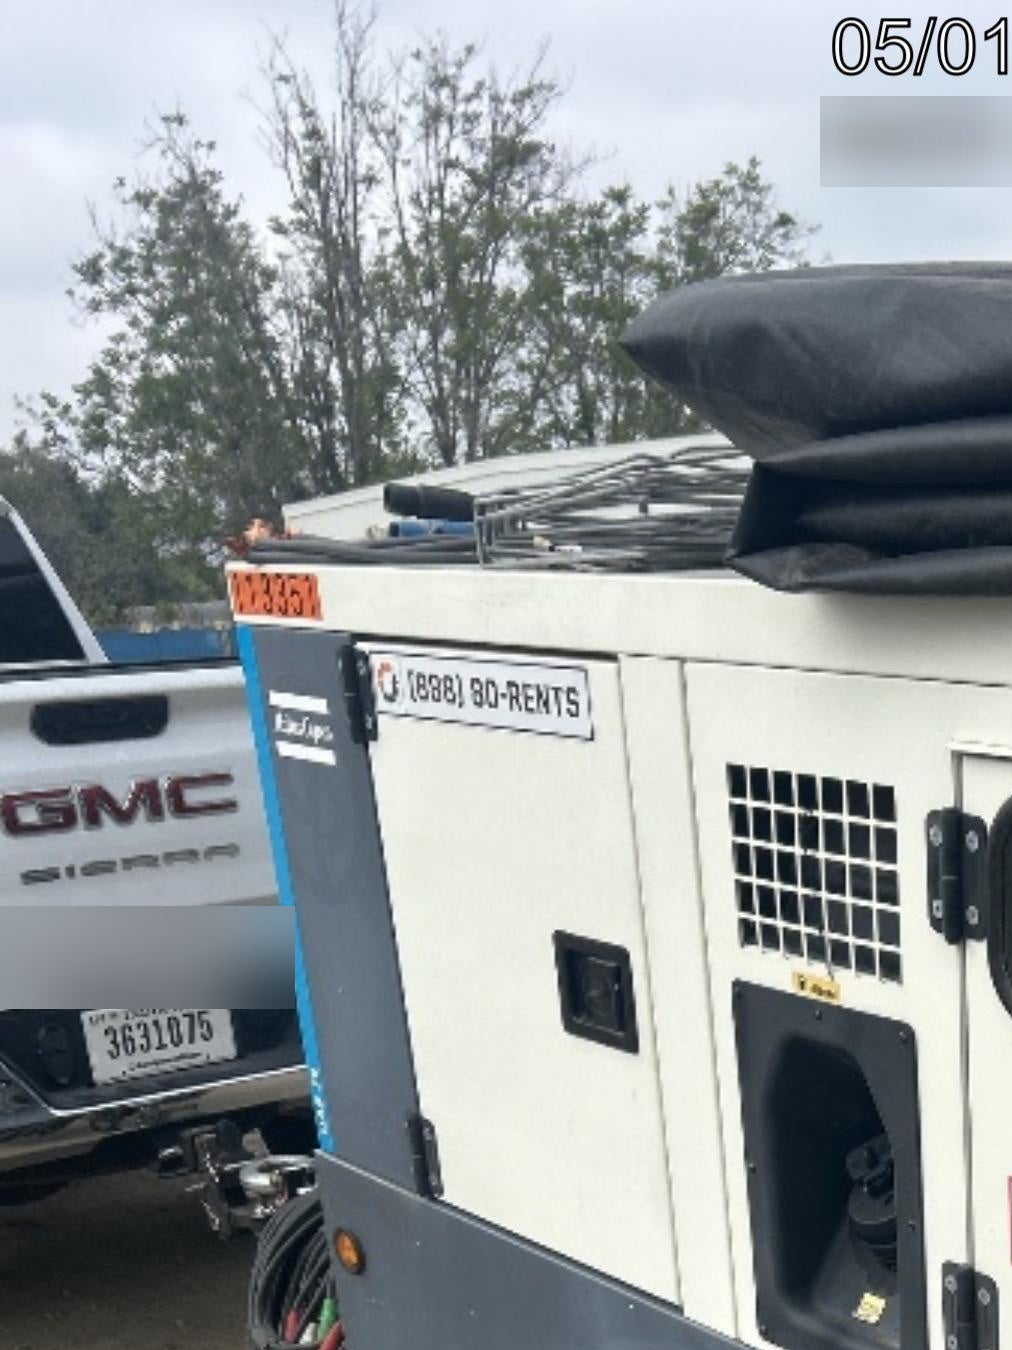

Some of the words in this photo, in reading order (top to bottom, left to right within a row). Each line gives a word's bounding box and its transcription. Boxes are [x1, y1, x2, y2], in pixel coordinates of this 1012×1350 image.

[232, 571, 318, 617] 113351
[408, 668, 463, 709] (888)
[469, 676, 581, 718] 80-RENTS
[0, 772, 238, 837] GMC
[20, 842, 241, 885] SIERRA
[103, 1009, 214, 1060] 3631075
